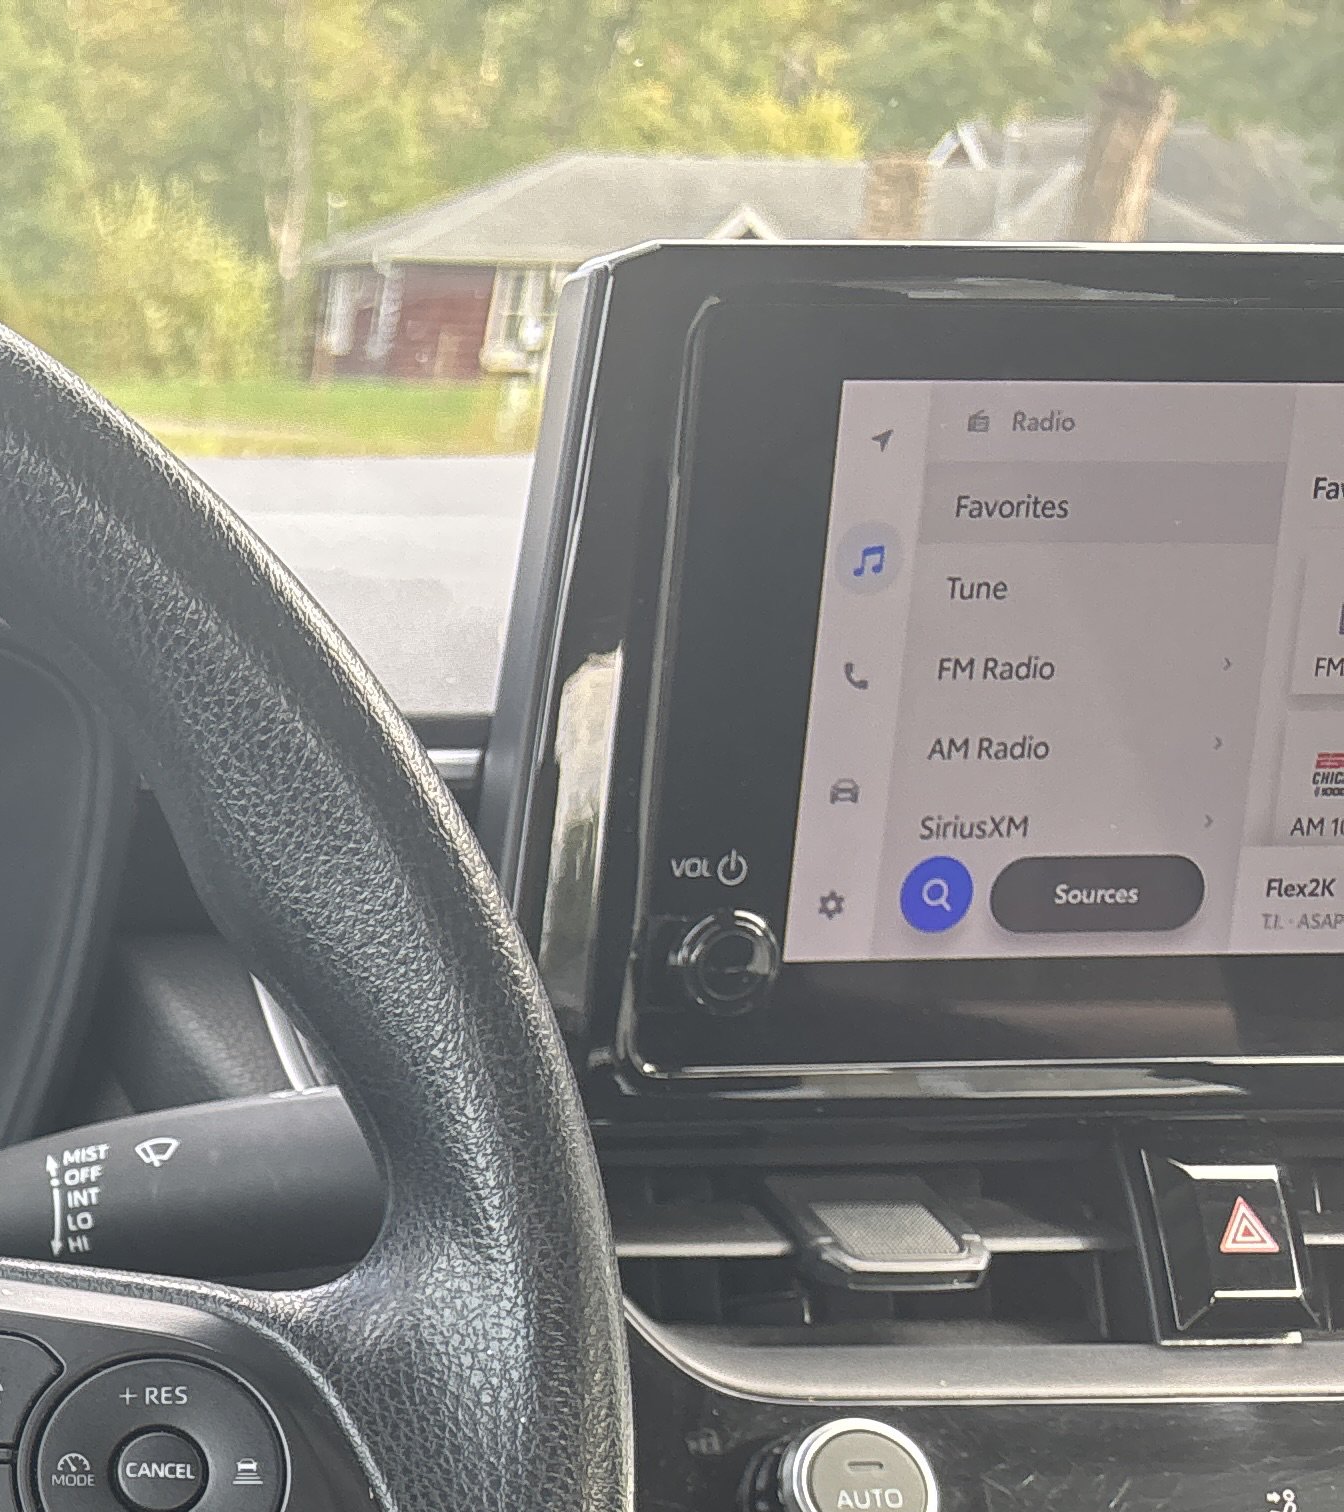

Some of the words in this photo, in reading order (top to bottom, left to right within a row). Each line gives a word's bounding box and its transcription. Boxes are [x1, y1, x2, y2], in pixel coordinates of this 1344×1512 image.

[1011, 410, 1076, 434] Radio
[954, 495, 1070, 520] Favorites
[946, 576, 1009, 601] Tune
[937, 658, 976, 681] FM
[982, 656, 1056, 682] Radio
[927, 737, 970, 761] AM
[976, 736, 1051, 761] Radio
[919, 815, 1030, 841] SiriusXM
[1290, 817, 1325, 837] AM
[671, 857, 713, 878] VOL
[1053, 883, 1139, 906] Sources
[1265, 877, 1337, 899] Flex2K
[1296, 912, 1344, 931] ASAP
[63, 1143, 110, 1167] MIST
[63, 1165, 103, 1187] OFF
[66, 1187, 101, 1210] INT
[67, 1211, 94, 1232] LO
[67, 1234, 91, 1254] HI
[144, 1385, 189, 1406] RES
[51, 1471, 96, 1489] MODE
[125, 1461, 196, 1482] CANCEL
[836, 1487, 904, 1510] AUTO
